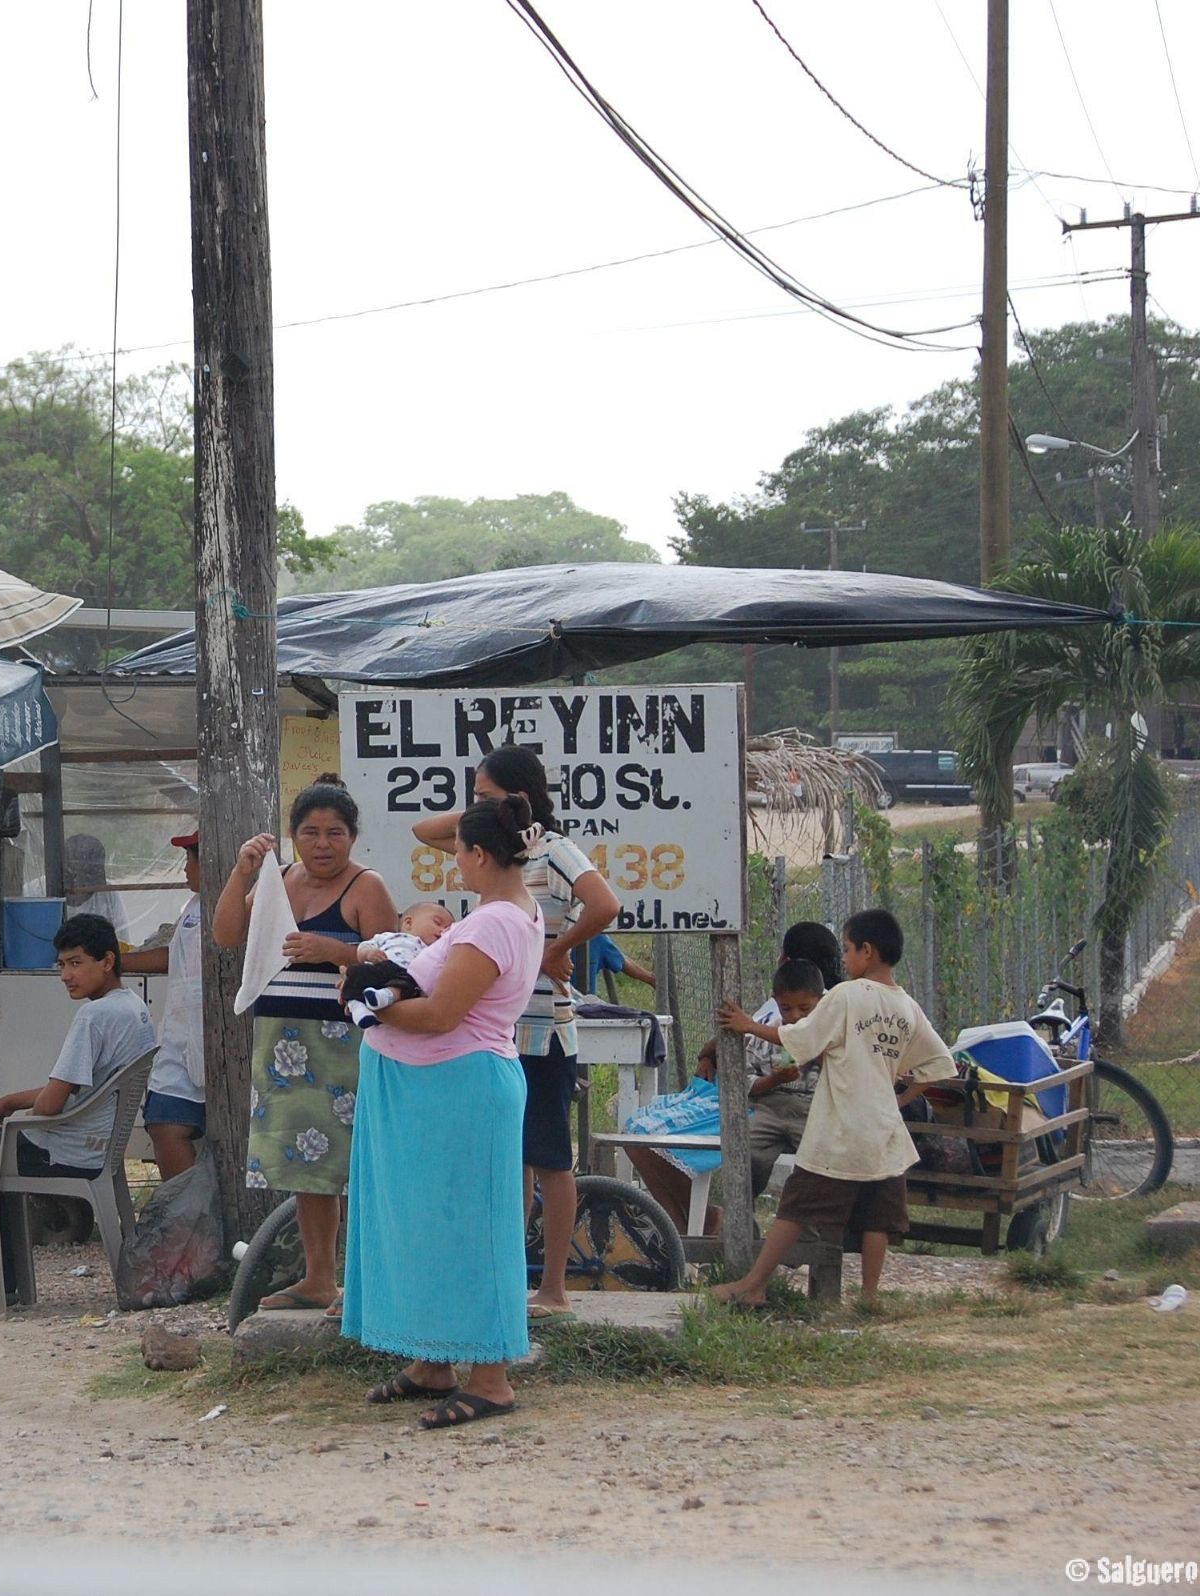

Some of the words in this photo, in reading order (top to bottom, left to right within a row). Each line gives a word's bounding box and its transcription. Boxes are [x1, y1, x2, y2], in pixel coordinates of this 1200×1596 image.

[356, 699, 442, 759] EL
[455, 695, 589, 758] REY
[599, 693, 706, 755] INN
[387, 763, 457, 812] 23
[465, 763, 607, 812] HO
[615, 763, 693, 811] St.
[874, 1033, 898, 1045] OD
